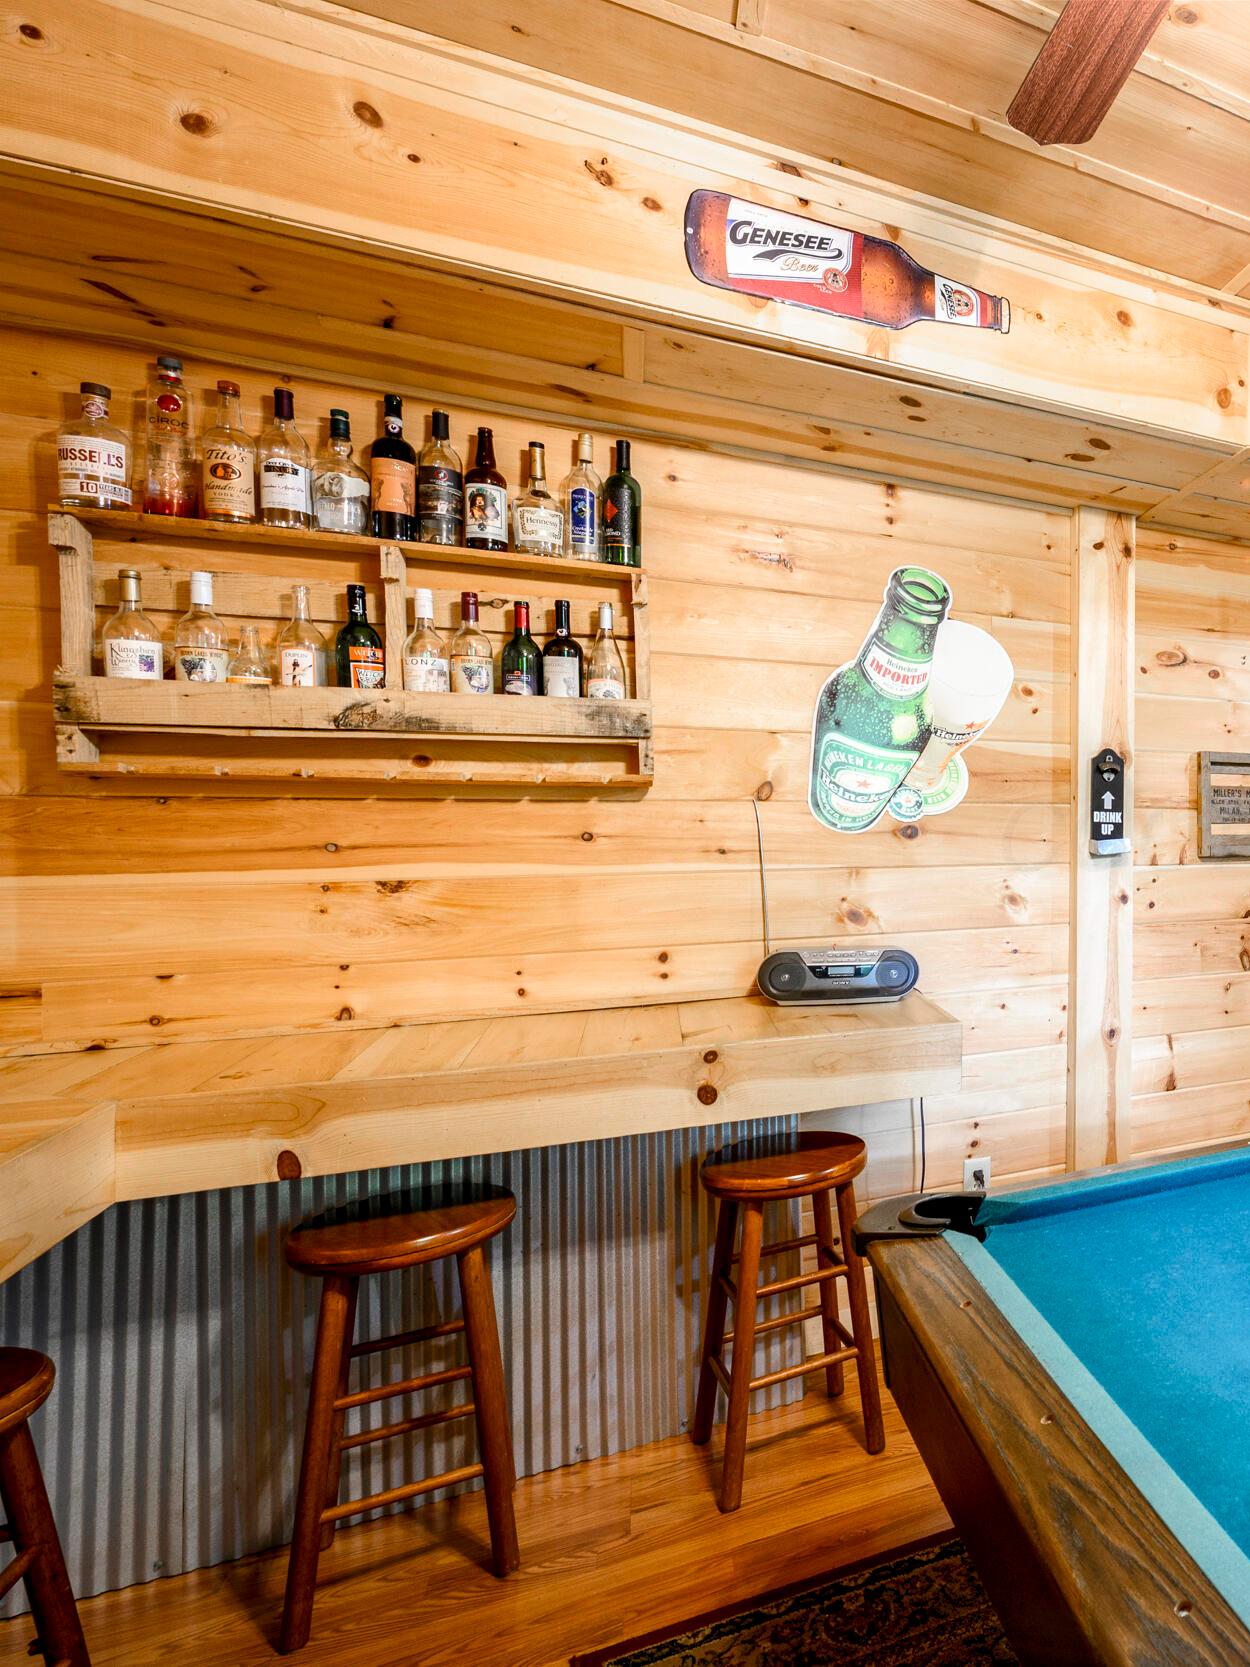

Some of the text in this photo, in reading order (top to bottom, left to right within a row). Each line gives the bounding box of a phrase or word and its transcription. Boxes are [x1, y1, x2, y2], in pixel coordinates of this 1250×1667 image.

[729, 220, 832, 251] GENESEE
[781, 257, 819, 272] Beer
[82, 482, 98, 494] 10
[526, 517, 558, 529] Hennessy
[870, 656, 928, 685] IMPORTED
[1213, 788, 1242, 798] MILLER'S
[1093, 811, 1122, 823] DRINK
[1101, 824, 1114, 835] UP
